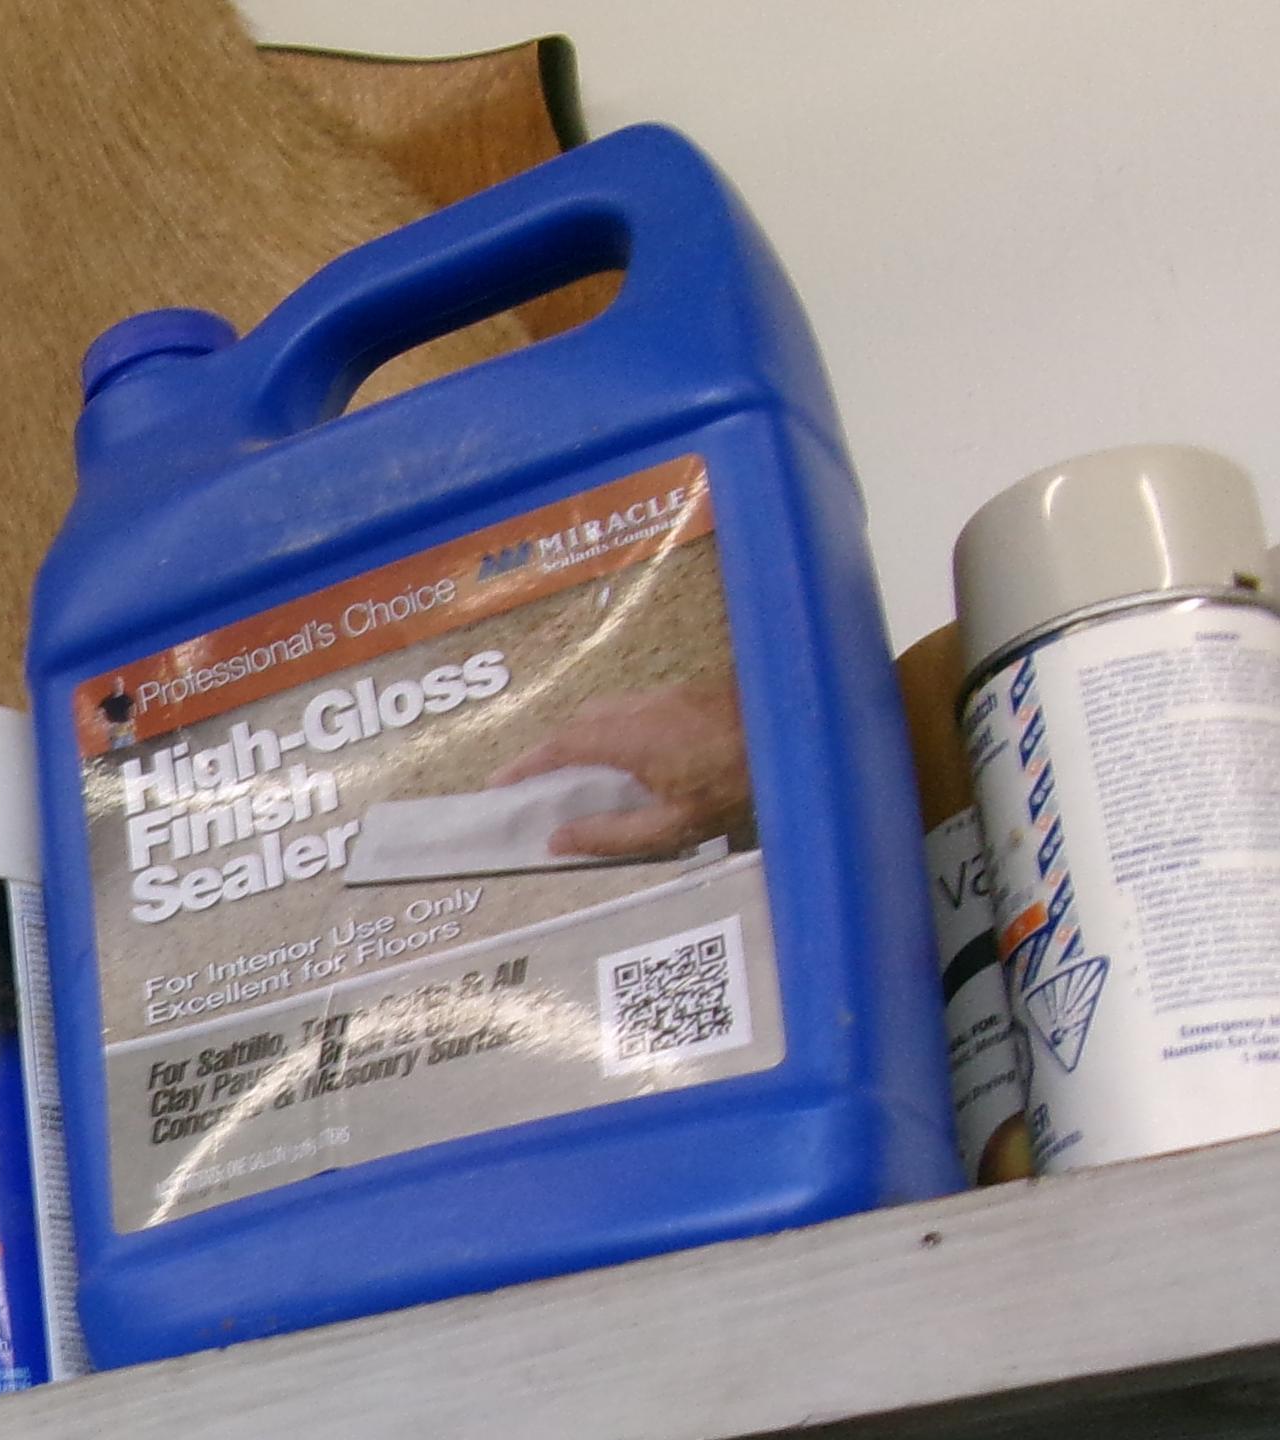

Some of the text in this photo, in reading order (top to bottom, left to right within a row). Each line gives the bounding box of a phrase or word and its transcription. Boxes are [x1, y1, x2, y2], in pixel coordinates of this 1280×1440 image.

[537, 486, 687, 558] MIRACLE
[543, 543, 609, 574] Sealants
[138, 576, 457, 713] Professional's Choice
[123, 648, 511, 817] High-Gloss
[126, 763, 339, 872] Finish
[132, 818, 362, 925] Sealer
[146, 886, 485, 1002] For Interior Use Only
[146, 919, 462, 1027] Excellent for Floors
[147, 1060, 187, 1091] For
[491, 956, 530, 992] All
[301, 1046, 421, 1100] Masonry
[150, 1078, 207, 1119] Clay
